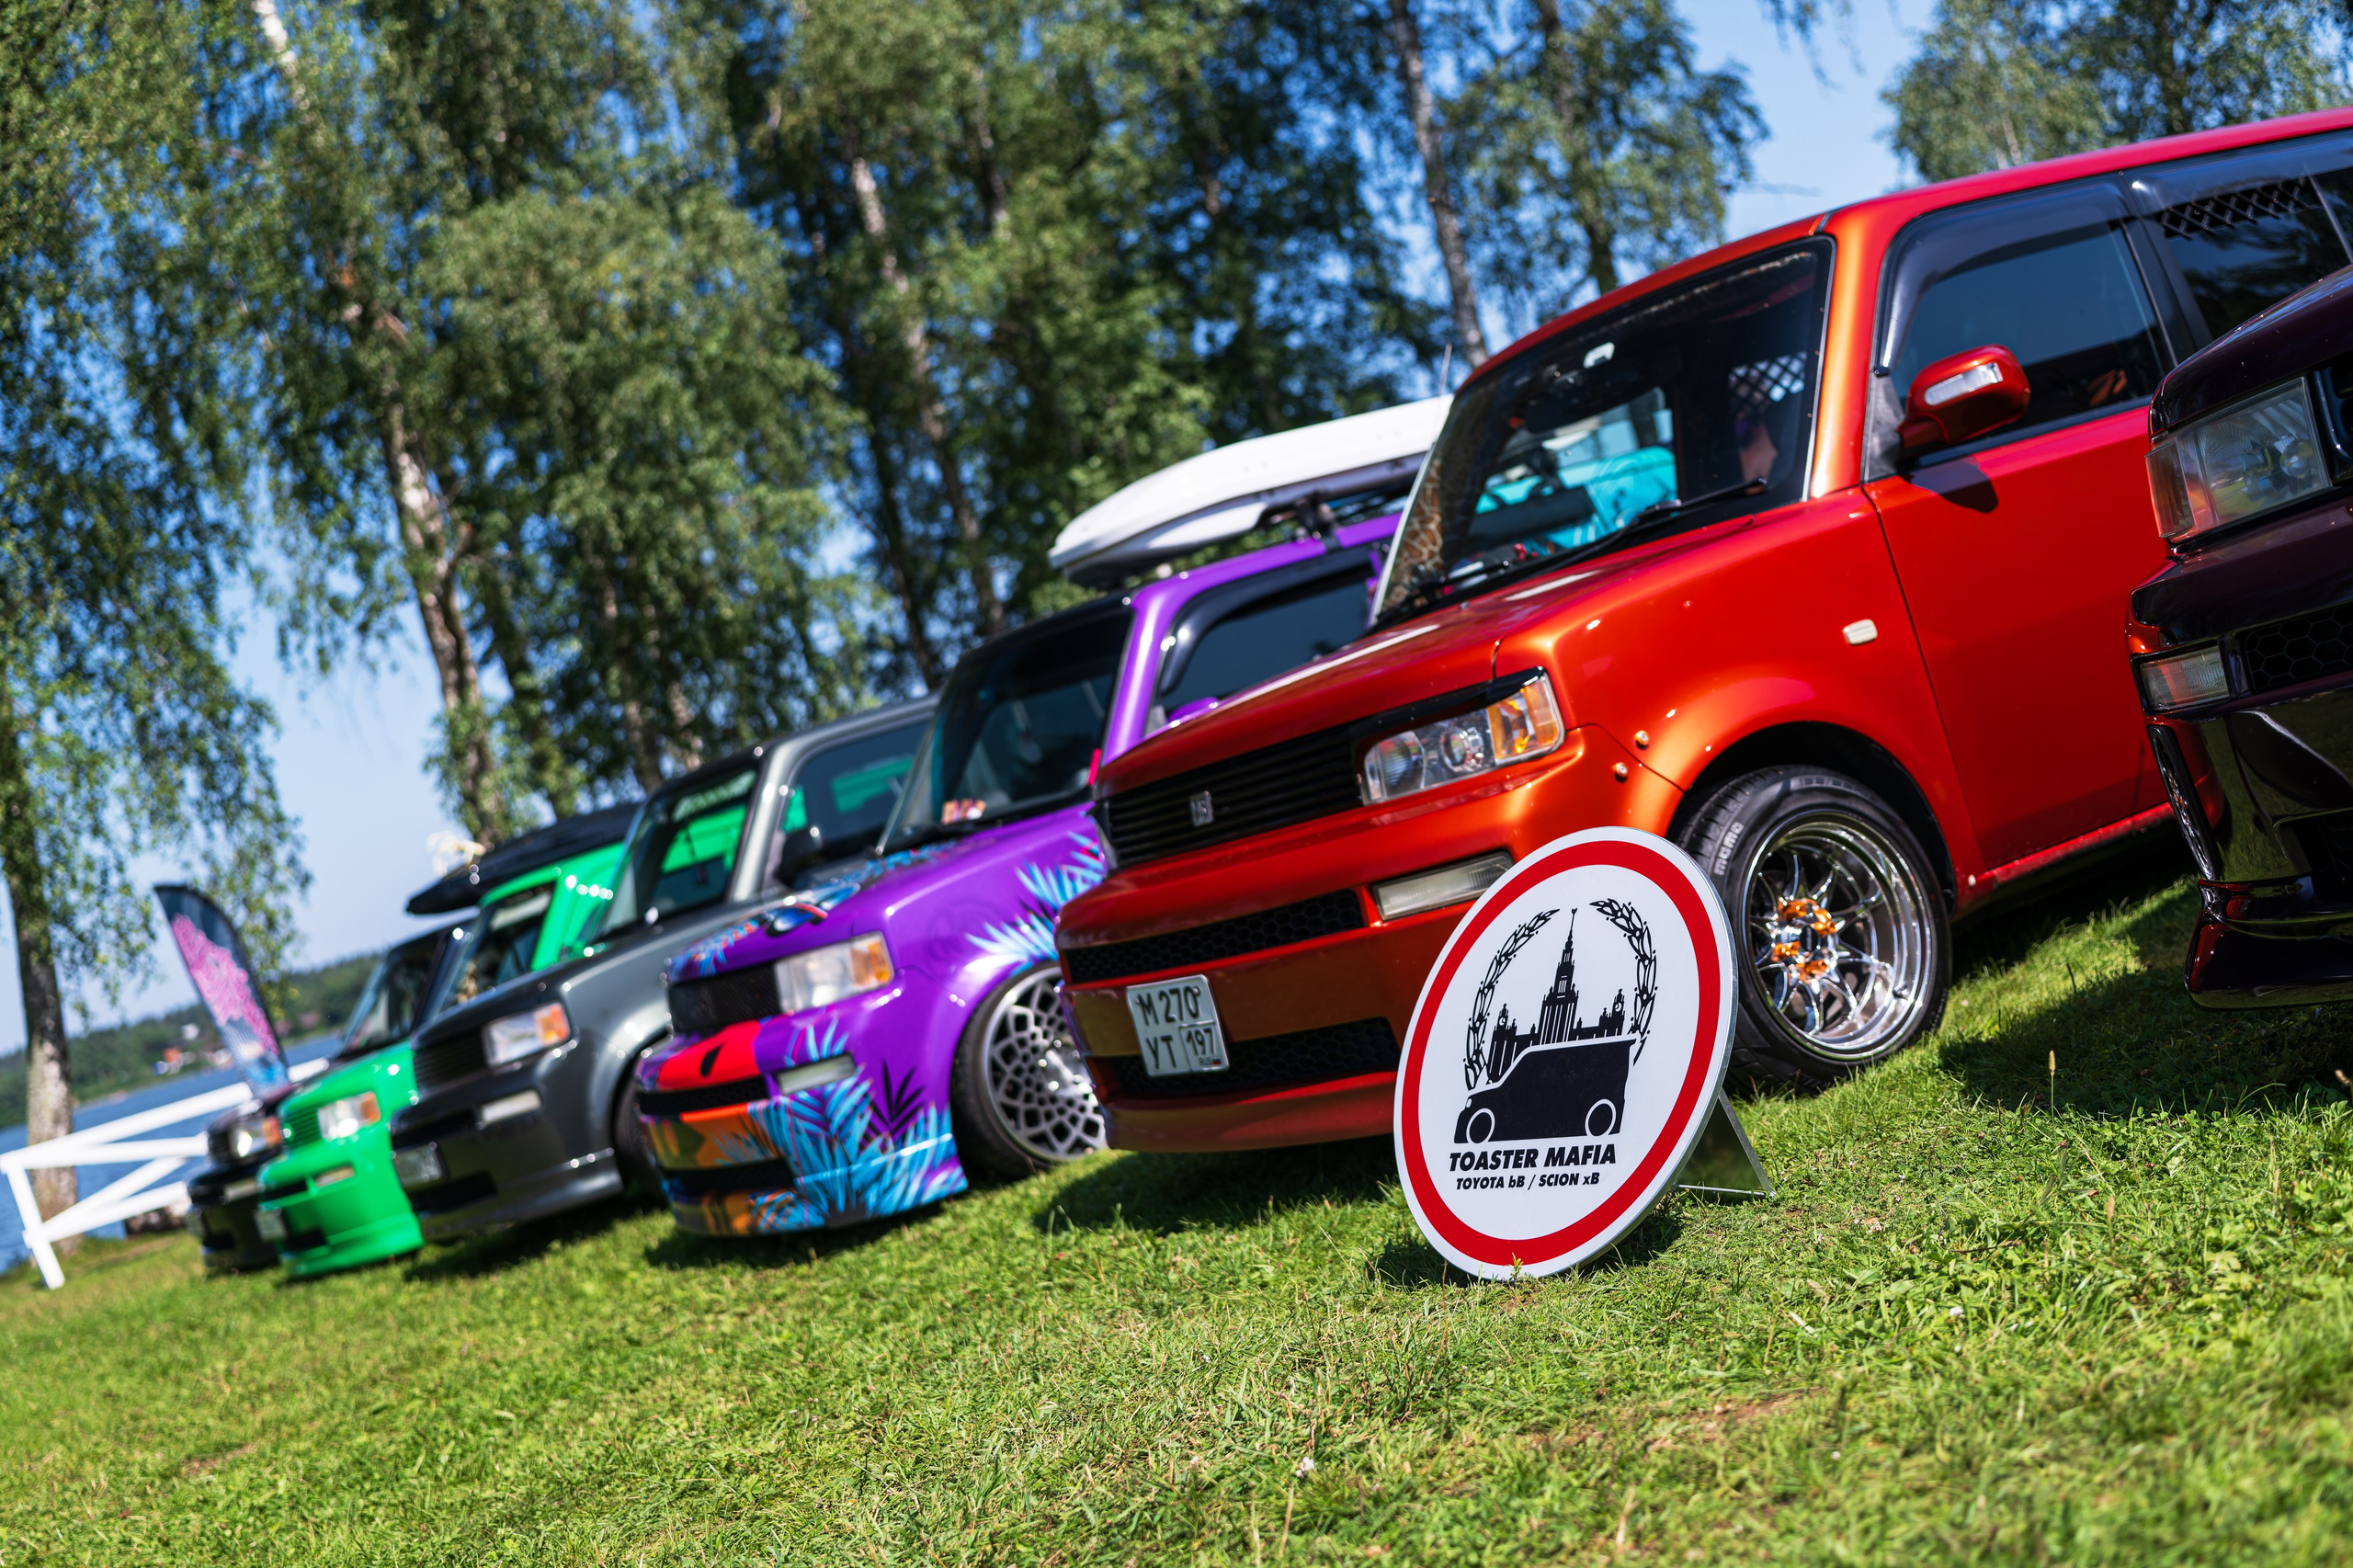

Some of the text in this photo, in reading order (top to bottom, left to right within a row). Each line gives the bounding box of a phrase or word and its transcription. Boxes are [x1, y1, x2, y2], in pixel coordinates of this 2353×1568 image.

[1187, 1028, 1215, 1056] 197
[1449, 1143, 1616, 1172] TOASTER MAFIA
[1456, 1176, 1504, 1190] TOYOTA
[1508, 1176, 1525, 1188] bB
[1539, 1173, 1579, 1187] SCION
[1582, 1172, 1600, 1185] xB
